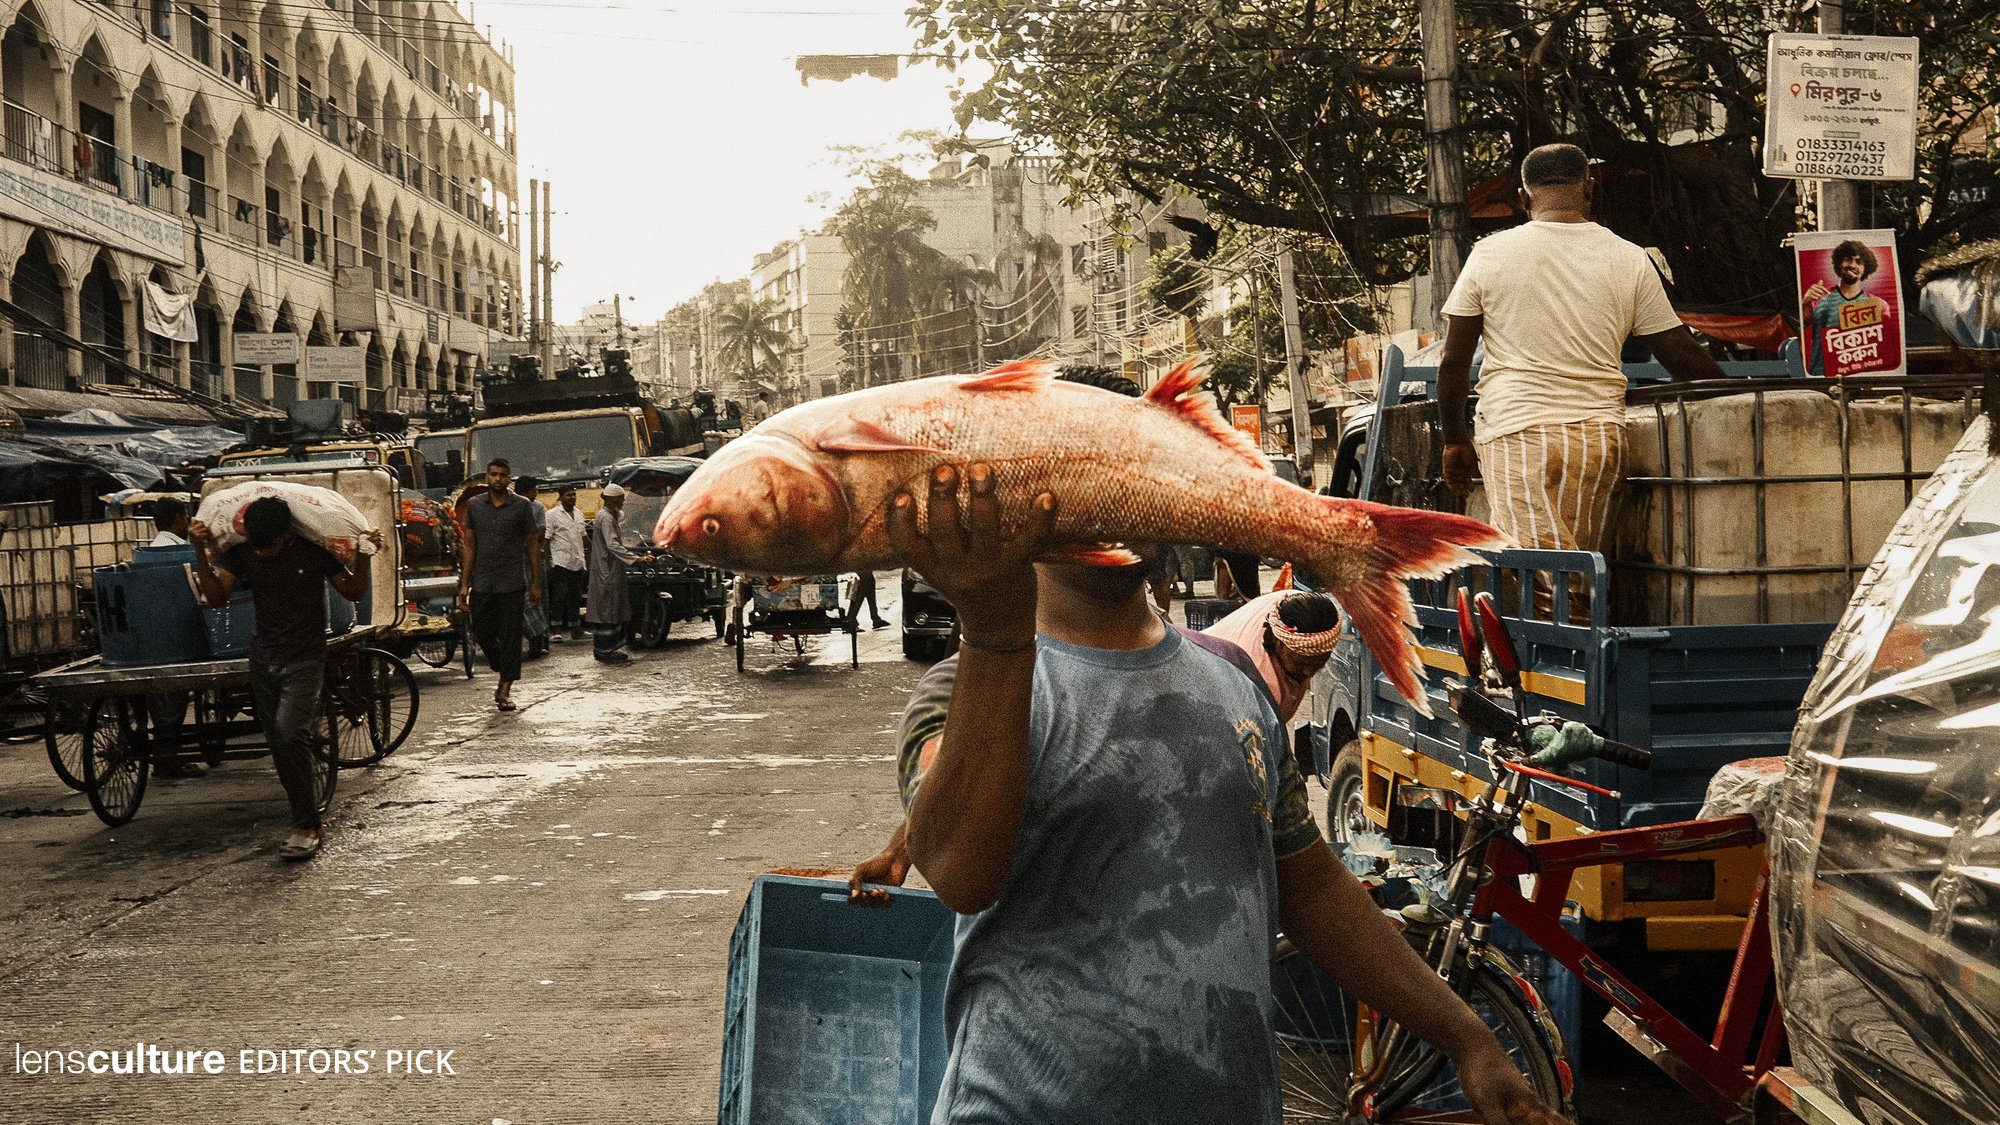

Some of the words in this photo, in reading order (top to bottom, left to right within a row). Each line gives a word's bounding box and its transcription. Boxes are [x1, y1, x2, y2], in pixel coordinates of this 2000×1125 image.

[1777, 46, 1813, 60] আধুনিক
[1801, 62, 1839, 79] বিক্রয়
[1797, 138, 1885, 152] 01833314163
[1795, 150, 1885, 164] 01329729437
[1795, 162, 1884, 176] 01886240225
[1842, 304, 1877, 328] বিল
[1825, 324, 1884, 353] বিকাশ
[1835, 342, 1878, 365] করুন
